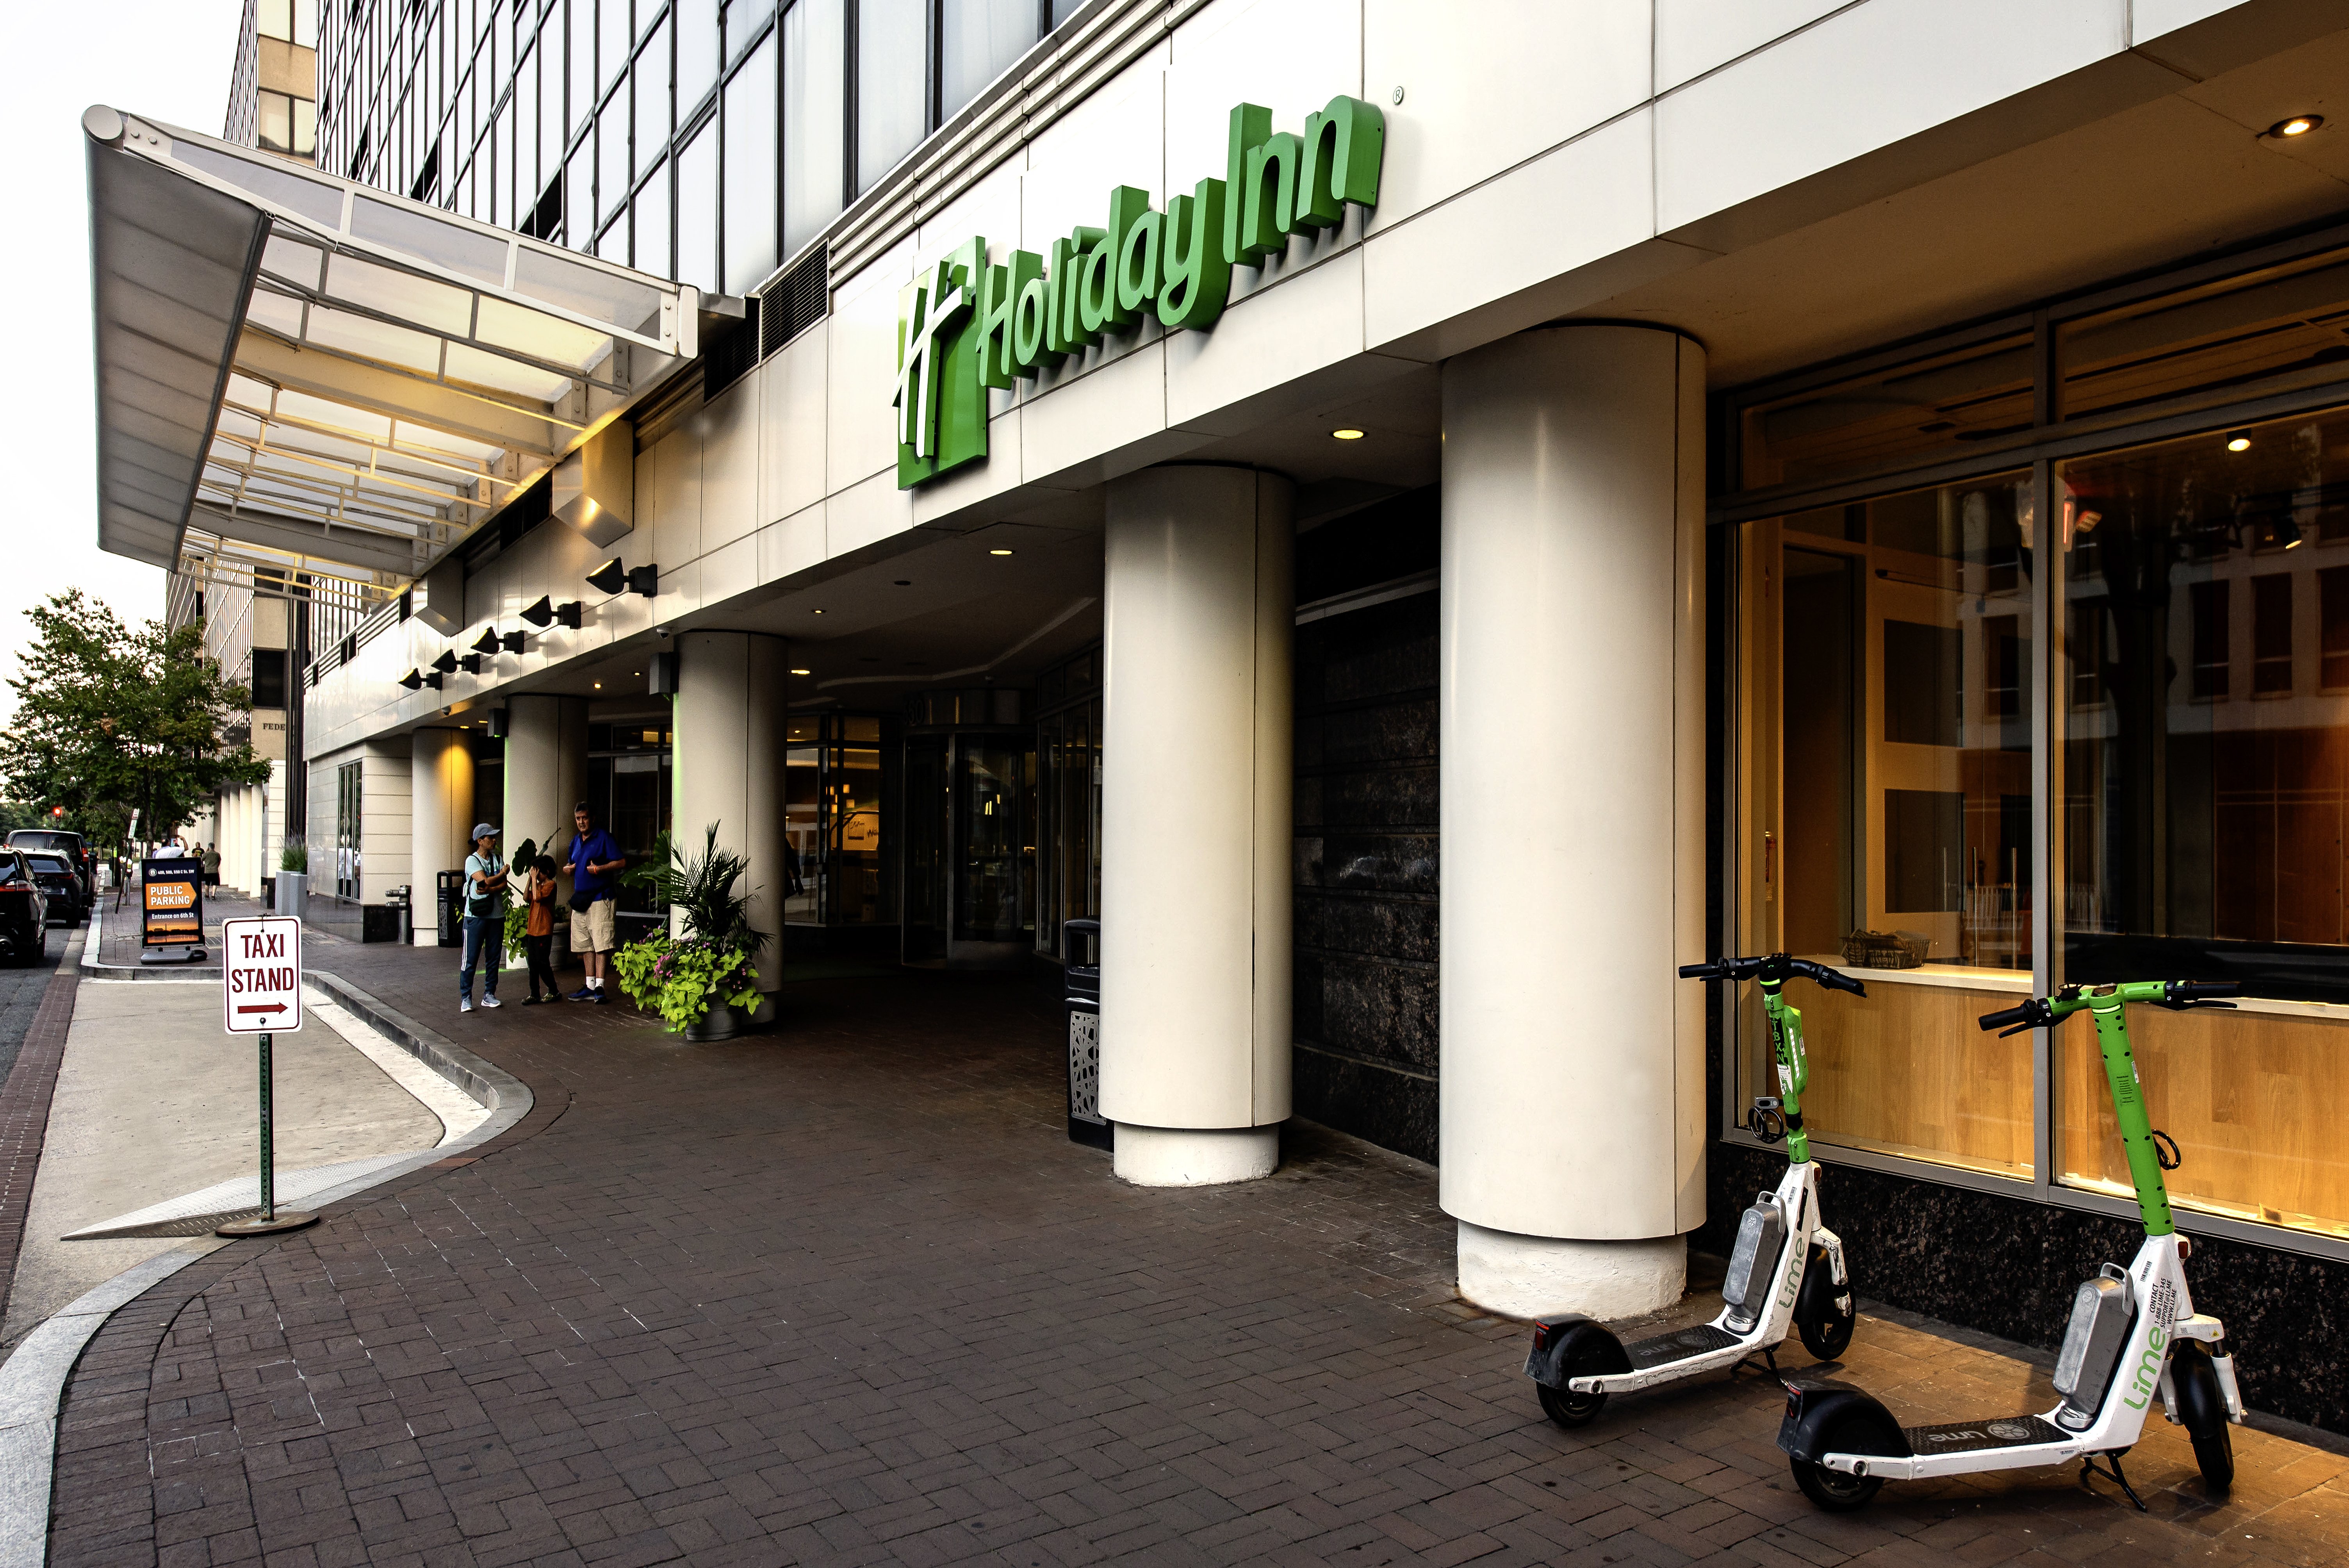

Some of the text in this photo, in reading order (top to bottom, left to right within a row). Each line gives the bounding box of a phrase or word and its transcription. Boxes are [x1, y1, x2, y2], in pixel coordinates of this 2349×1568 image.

[977, 177, 1230, 390] Holiday
[1223, 95, 1383, 267] Inn
[150, 886, 183, 896] PUBLIC
[151, 895, 190, 906] PARKING
[241, 934, 284, 959] TAXI
[232, 967, 294, 993] STAND
[1778, 1237, 1805, 1308] Lime
[2149, 1283, 2159, 1313] CONTACT
[2154, 1278, 2166, 1325] 1-888-LIME-345
[2160, 1279, 2172, 1329] SUPPORT@LI.ME
[2167, 1288, 2177, 1325] WWW.LI.ME
[2123, 1326, 2166, 1410] Lime
[1928, 1431, 1987, 1441] Lime
